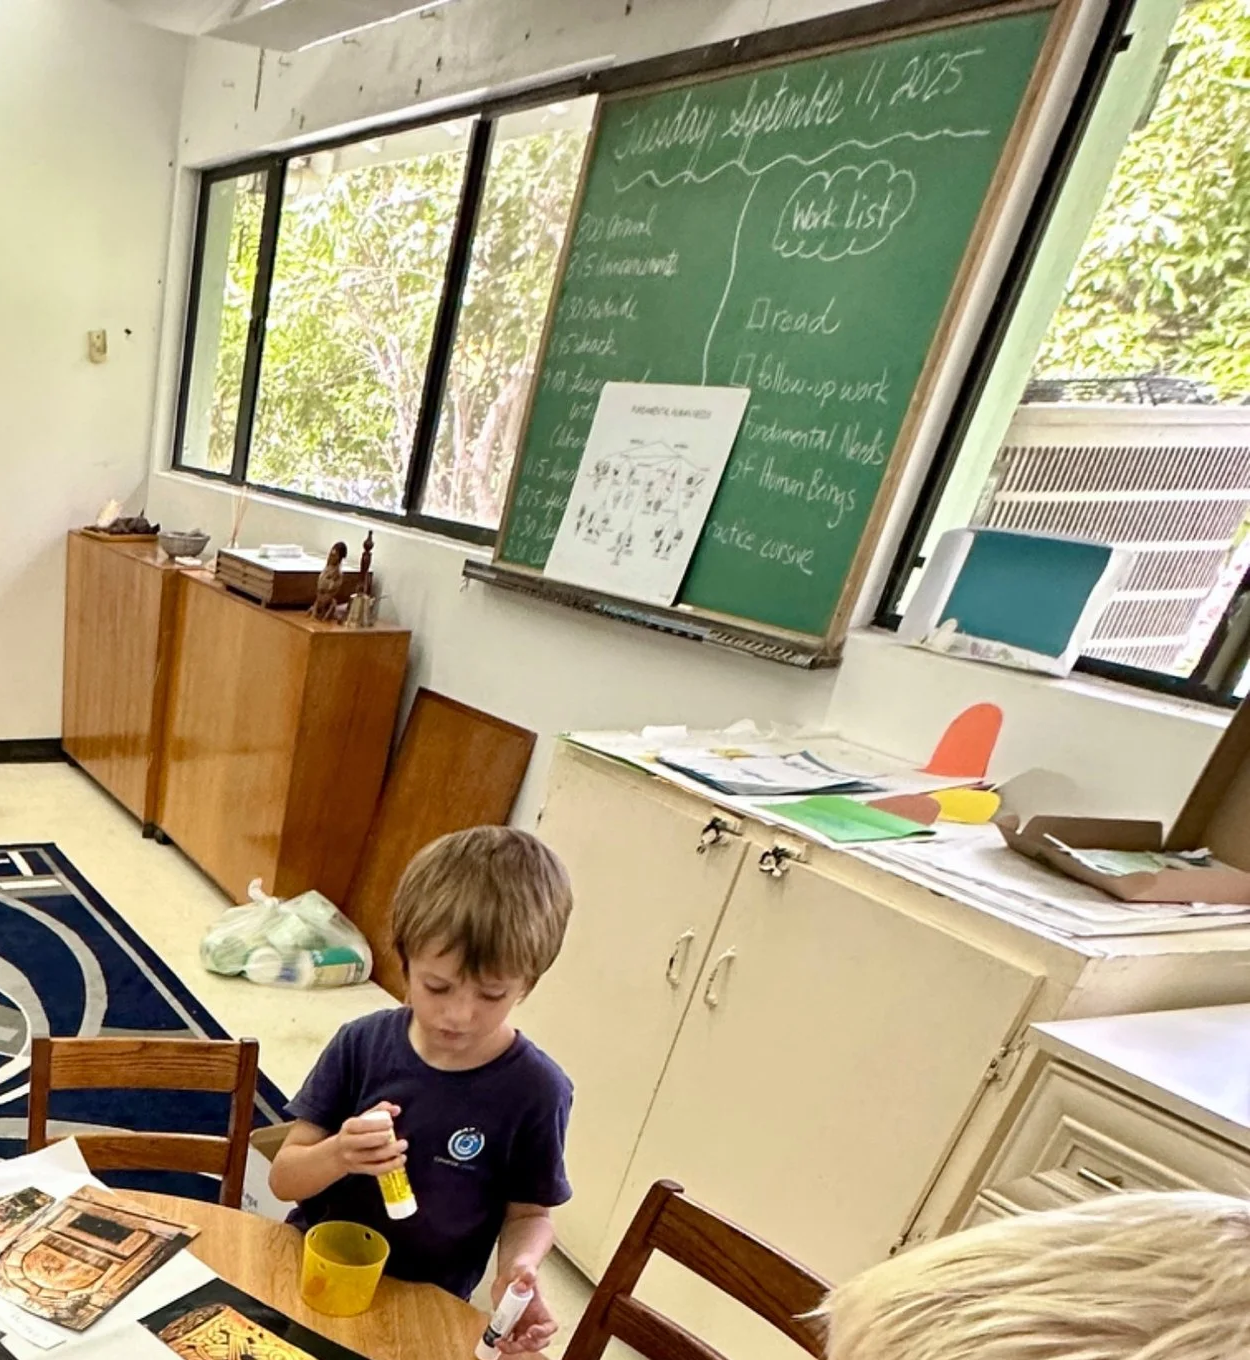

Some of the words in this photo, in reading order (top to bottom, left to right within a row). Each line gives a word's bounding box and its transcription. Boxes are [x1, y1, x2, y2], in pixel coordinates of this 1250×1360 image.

[723, 71, 845, 165] September
[890, 50, 986, 104] 2025
[792, 198, 837, 231] Work
[844, 190, 892, 229] List
[772, 296, 841, 334] read
[757, 354, 836, 407] follow-up
[840, 367, 890, 405] work
[741, 405, 839, 450] Fundamental
[840, 422, 884, 465] Needs
[728, 453, 756, 480] of
[759, 456, 804, 501] Human
[806, 468, 856, 529] Beings
[706, 520, 756, 550] ractice
[760, 536, 814, 575] cursive
